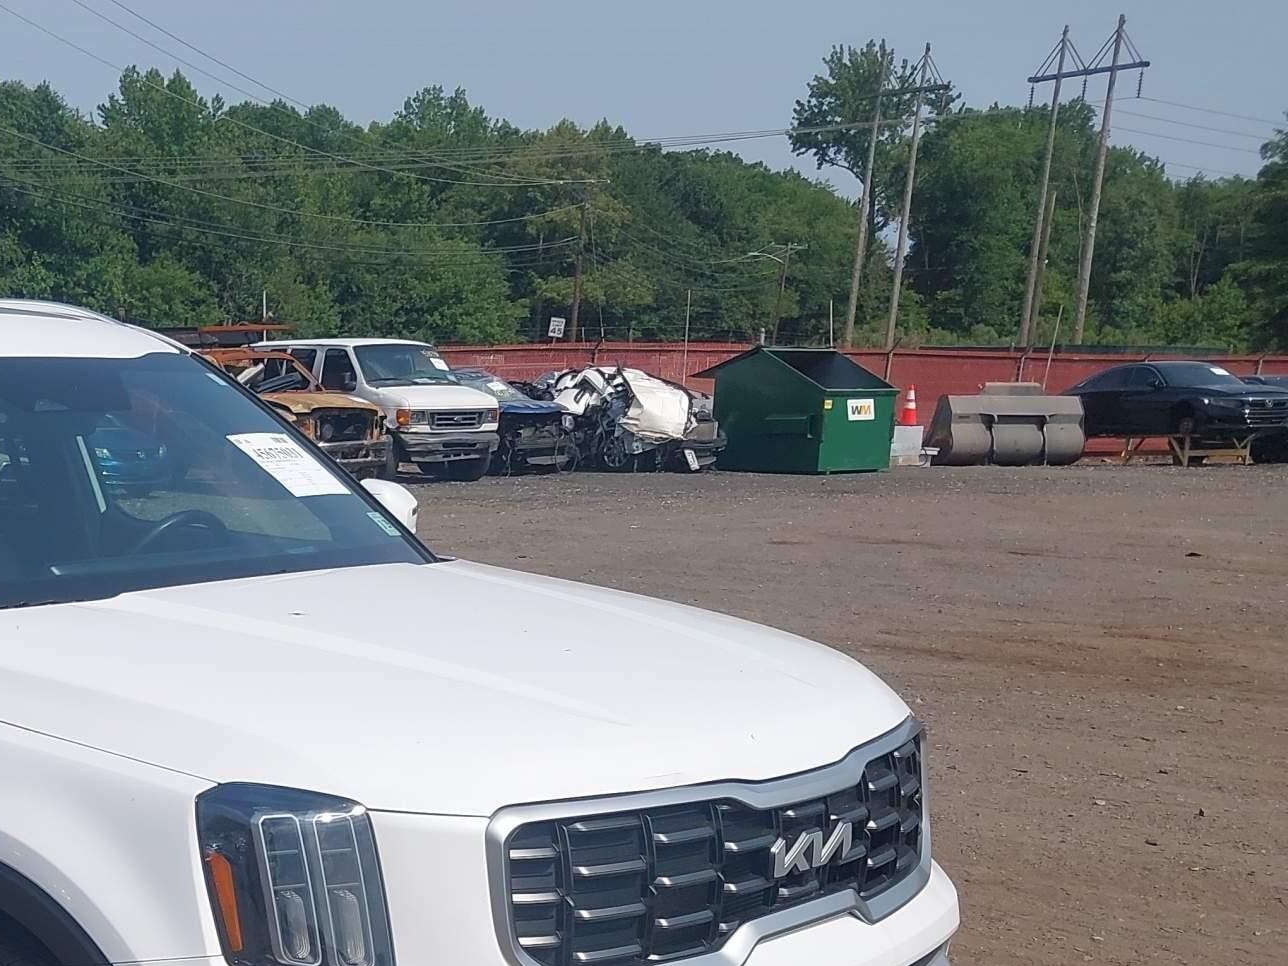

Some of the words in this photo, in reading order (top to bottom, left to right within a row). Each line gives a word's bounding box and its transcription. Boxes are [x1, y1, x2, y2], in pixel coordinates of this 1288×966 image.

[550, 327, 562, 336] 45
[851, 405, 872, 416] WM
[771, 819, 853, 878] KIA
